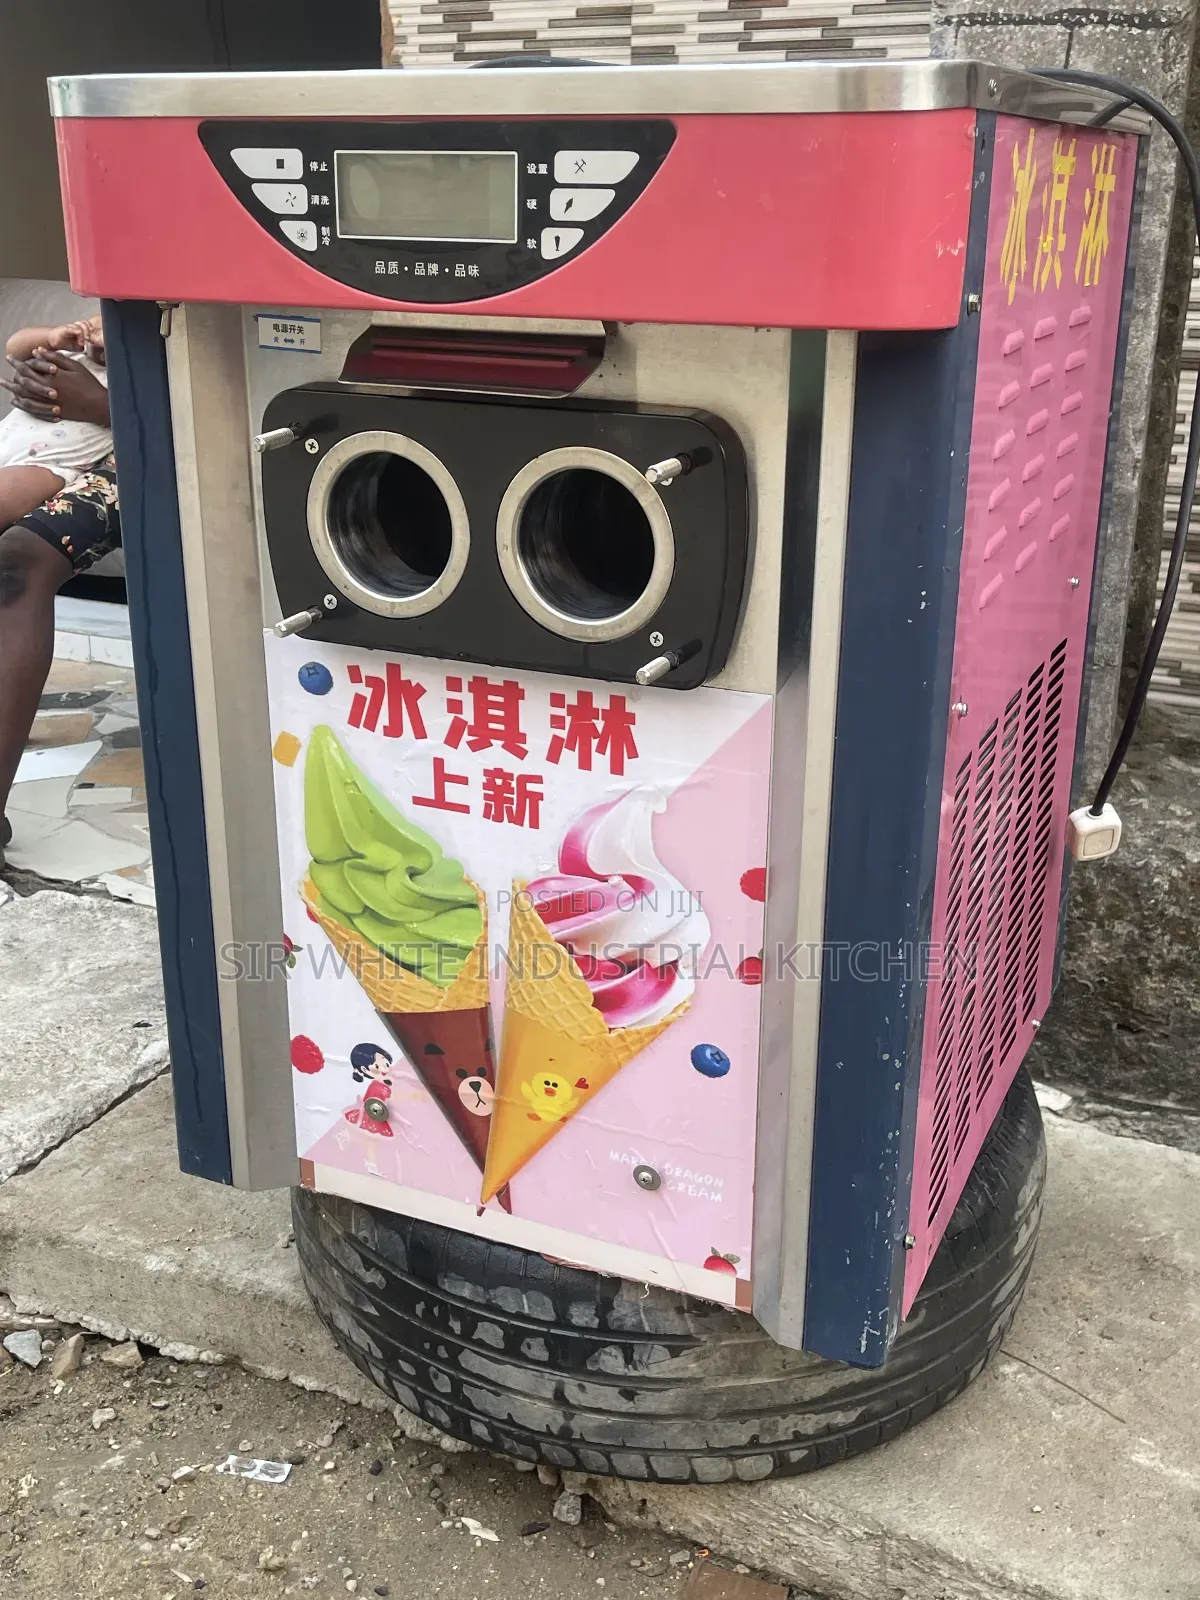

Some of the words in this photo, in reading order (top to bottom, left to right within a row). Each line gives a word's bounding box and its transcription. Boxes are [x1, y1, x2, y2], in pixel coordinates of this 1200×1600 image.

[309, 161, 328, 172] 停止
[526, 163, 548, 175] 设置
[310, 195, 330, 206] 清洗
[526, 199, 538, 210] 硬
[1000, 127, 1117, 307] 冰淇淋
[320, 226, 331, 247] 制冷
[526, 238, 537, 249] 软
[272, 322, 305, 335] 电源开关
[346, 661, 640, 777] 冰淇淋
[411, 756, 545, 831] 上新
[664, 1164, 724, 1188] DRAGON
[667, 1180, 722, 1203] CREAM
